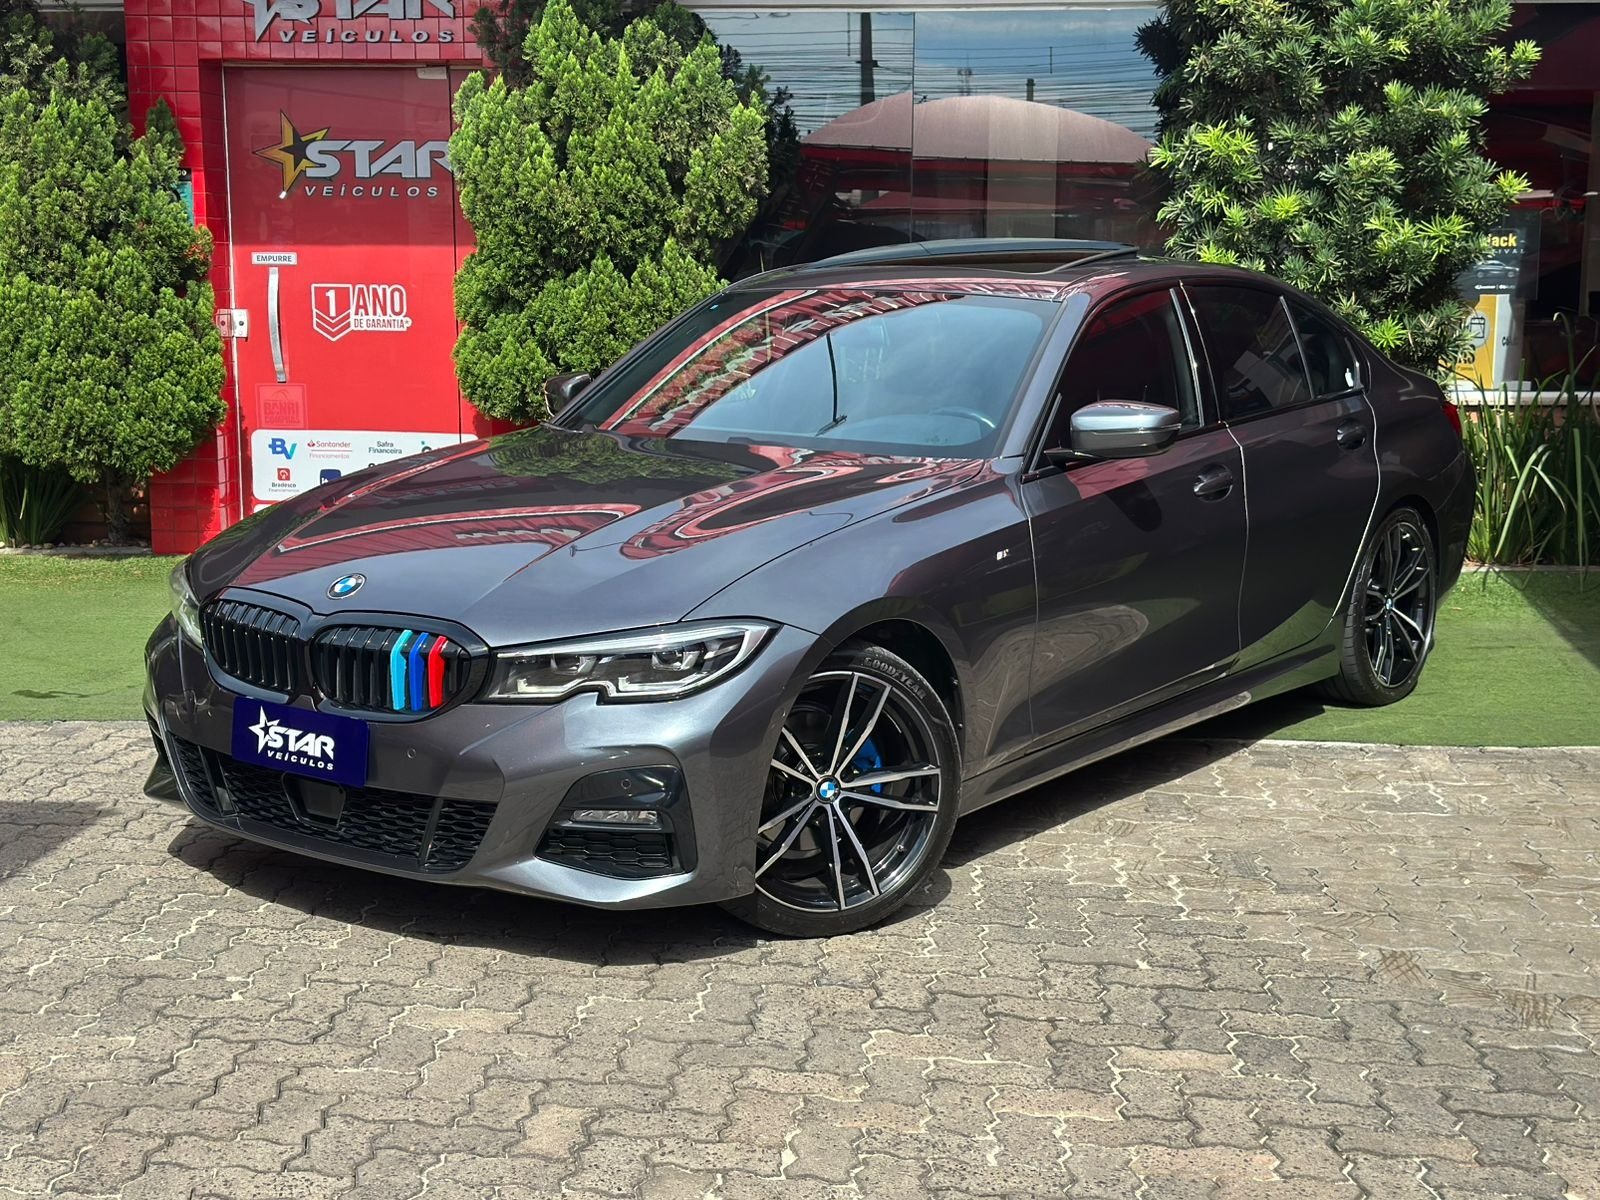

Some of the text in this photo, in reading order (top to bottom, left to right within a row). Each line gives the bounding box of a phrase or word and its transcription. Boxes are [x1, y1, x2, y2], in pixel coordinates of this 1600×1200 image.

[279, 28, 455, 43] VEÍCULOS
[305, 139, 453, 180] STAR
[304, 183, 439, 197] VEÍCULOS
[1487, 233, 1518, 247] jack
[325, 286, 405, 317] 1 ANO
[353, 318, 364, 328] DE
[316, 440, 351, 448] Santander
[267, 725, 335, 760] STAR
[267, 750, 334, 771] VEÍCULOS
